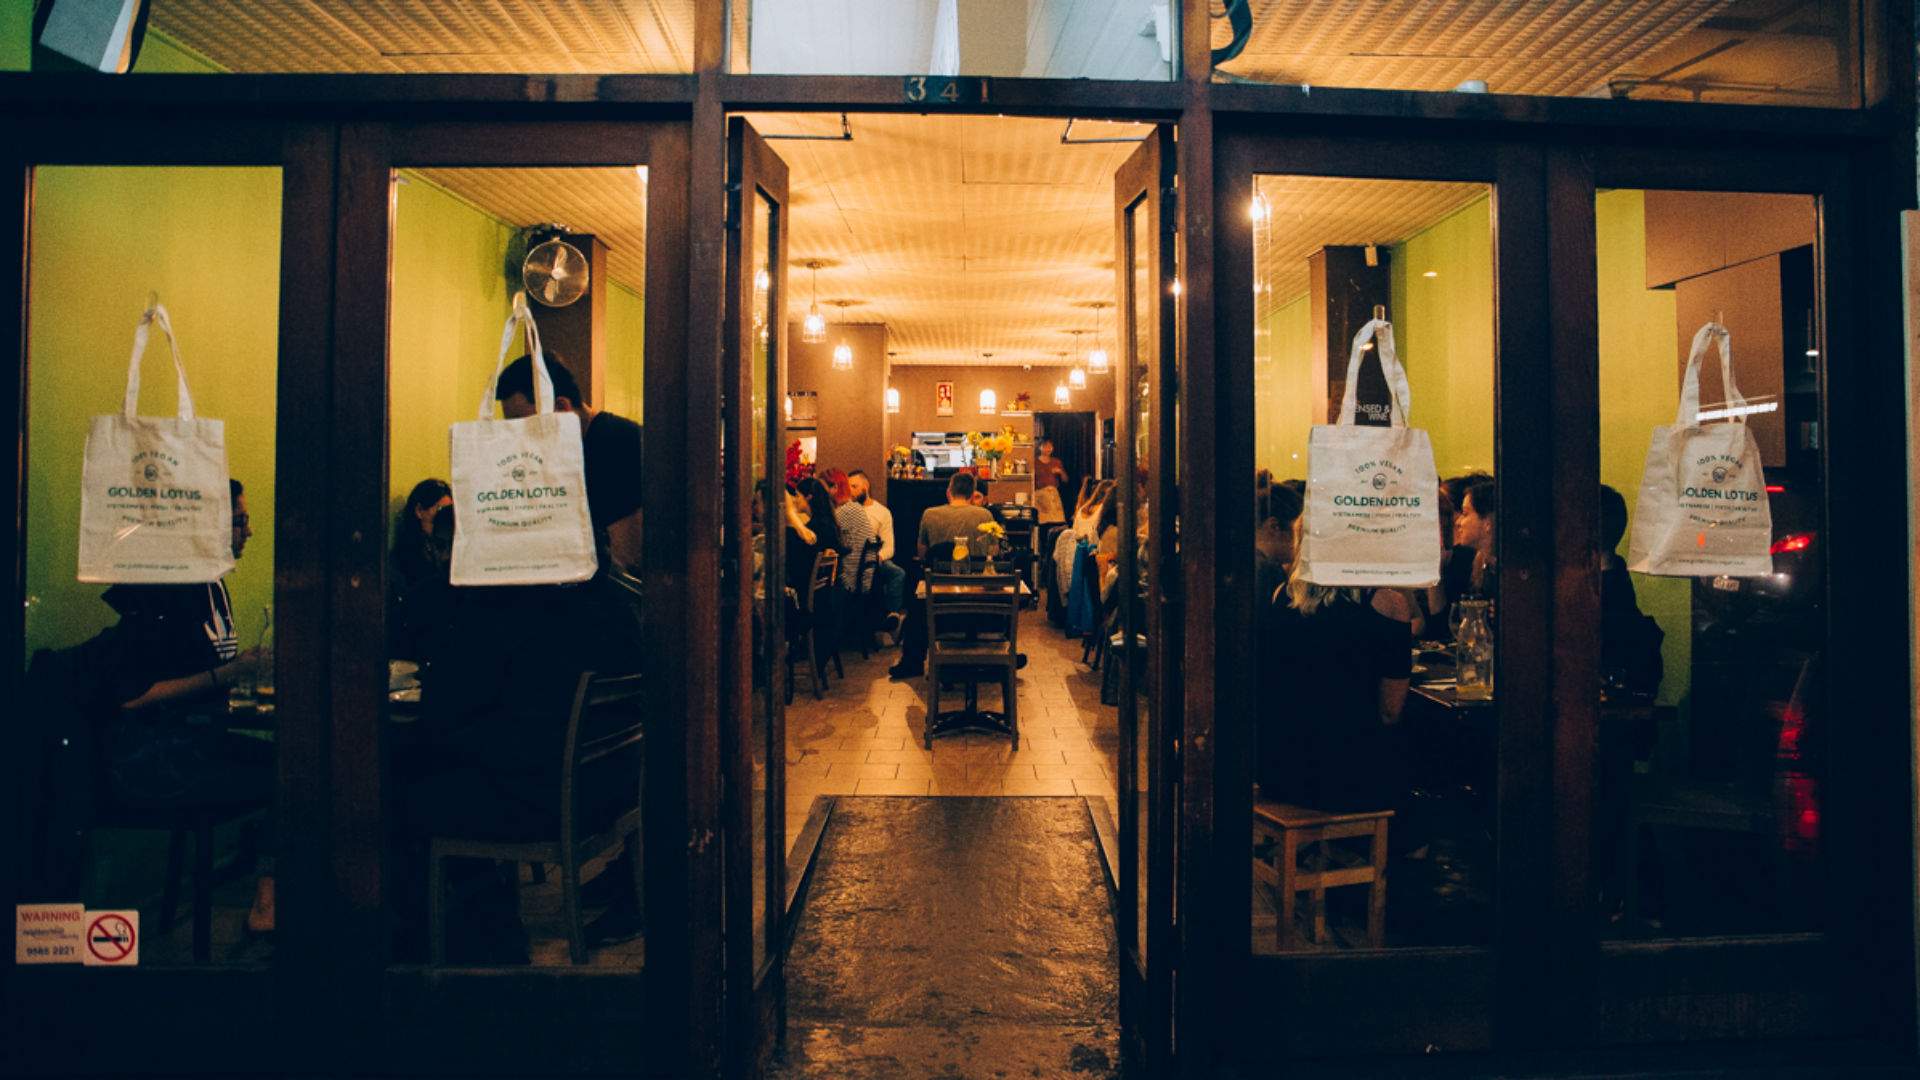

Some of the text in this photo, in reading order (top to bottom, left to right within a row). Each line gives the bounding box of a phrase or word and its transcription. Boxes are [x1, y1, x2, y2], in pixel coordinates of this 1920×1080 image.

[1355, 459, 1403, 475] 100% VEGAN
[1720, 455, 1743, 469] VEGAN
[108, 487, 202, 500] GOLDEN LOTUS
[477, 486, 567, 502] GOLDEN LOTUS
[1682, 487, 1758, 501] OLDEN LOTUS
[1334, 495, 1420, 507] GOLDEN LOTUS
[1347, 523, 1407, 535] PREMIUM QUALITY
[22, 911, 80, 922] WARNING
